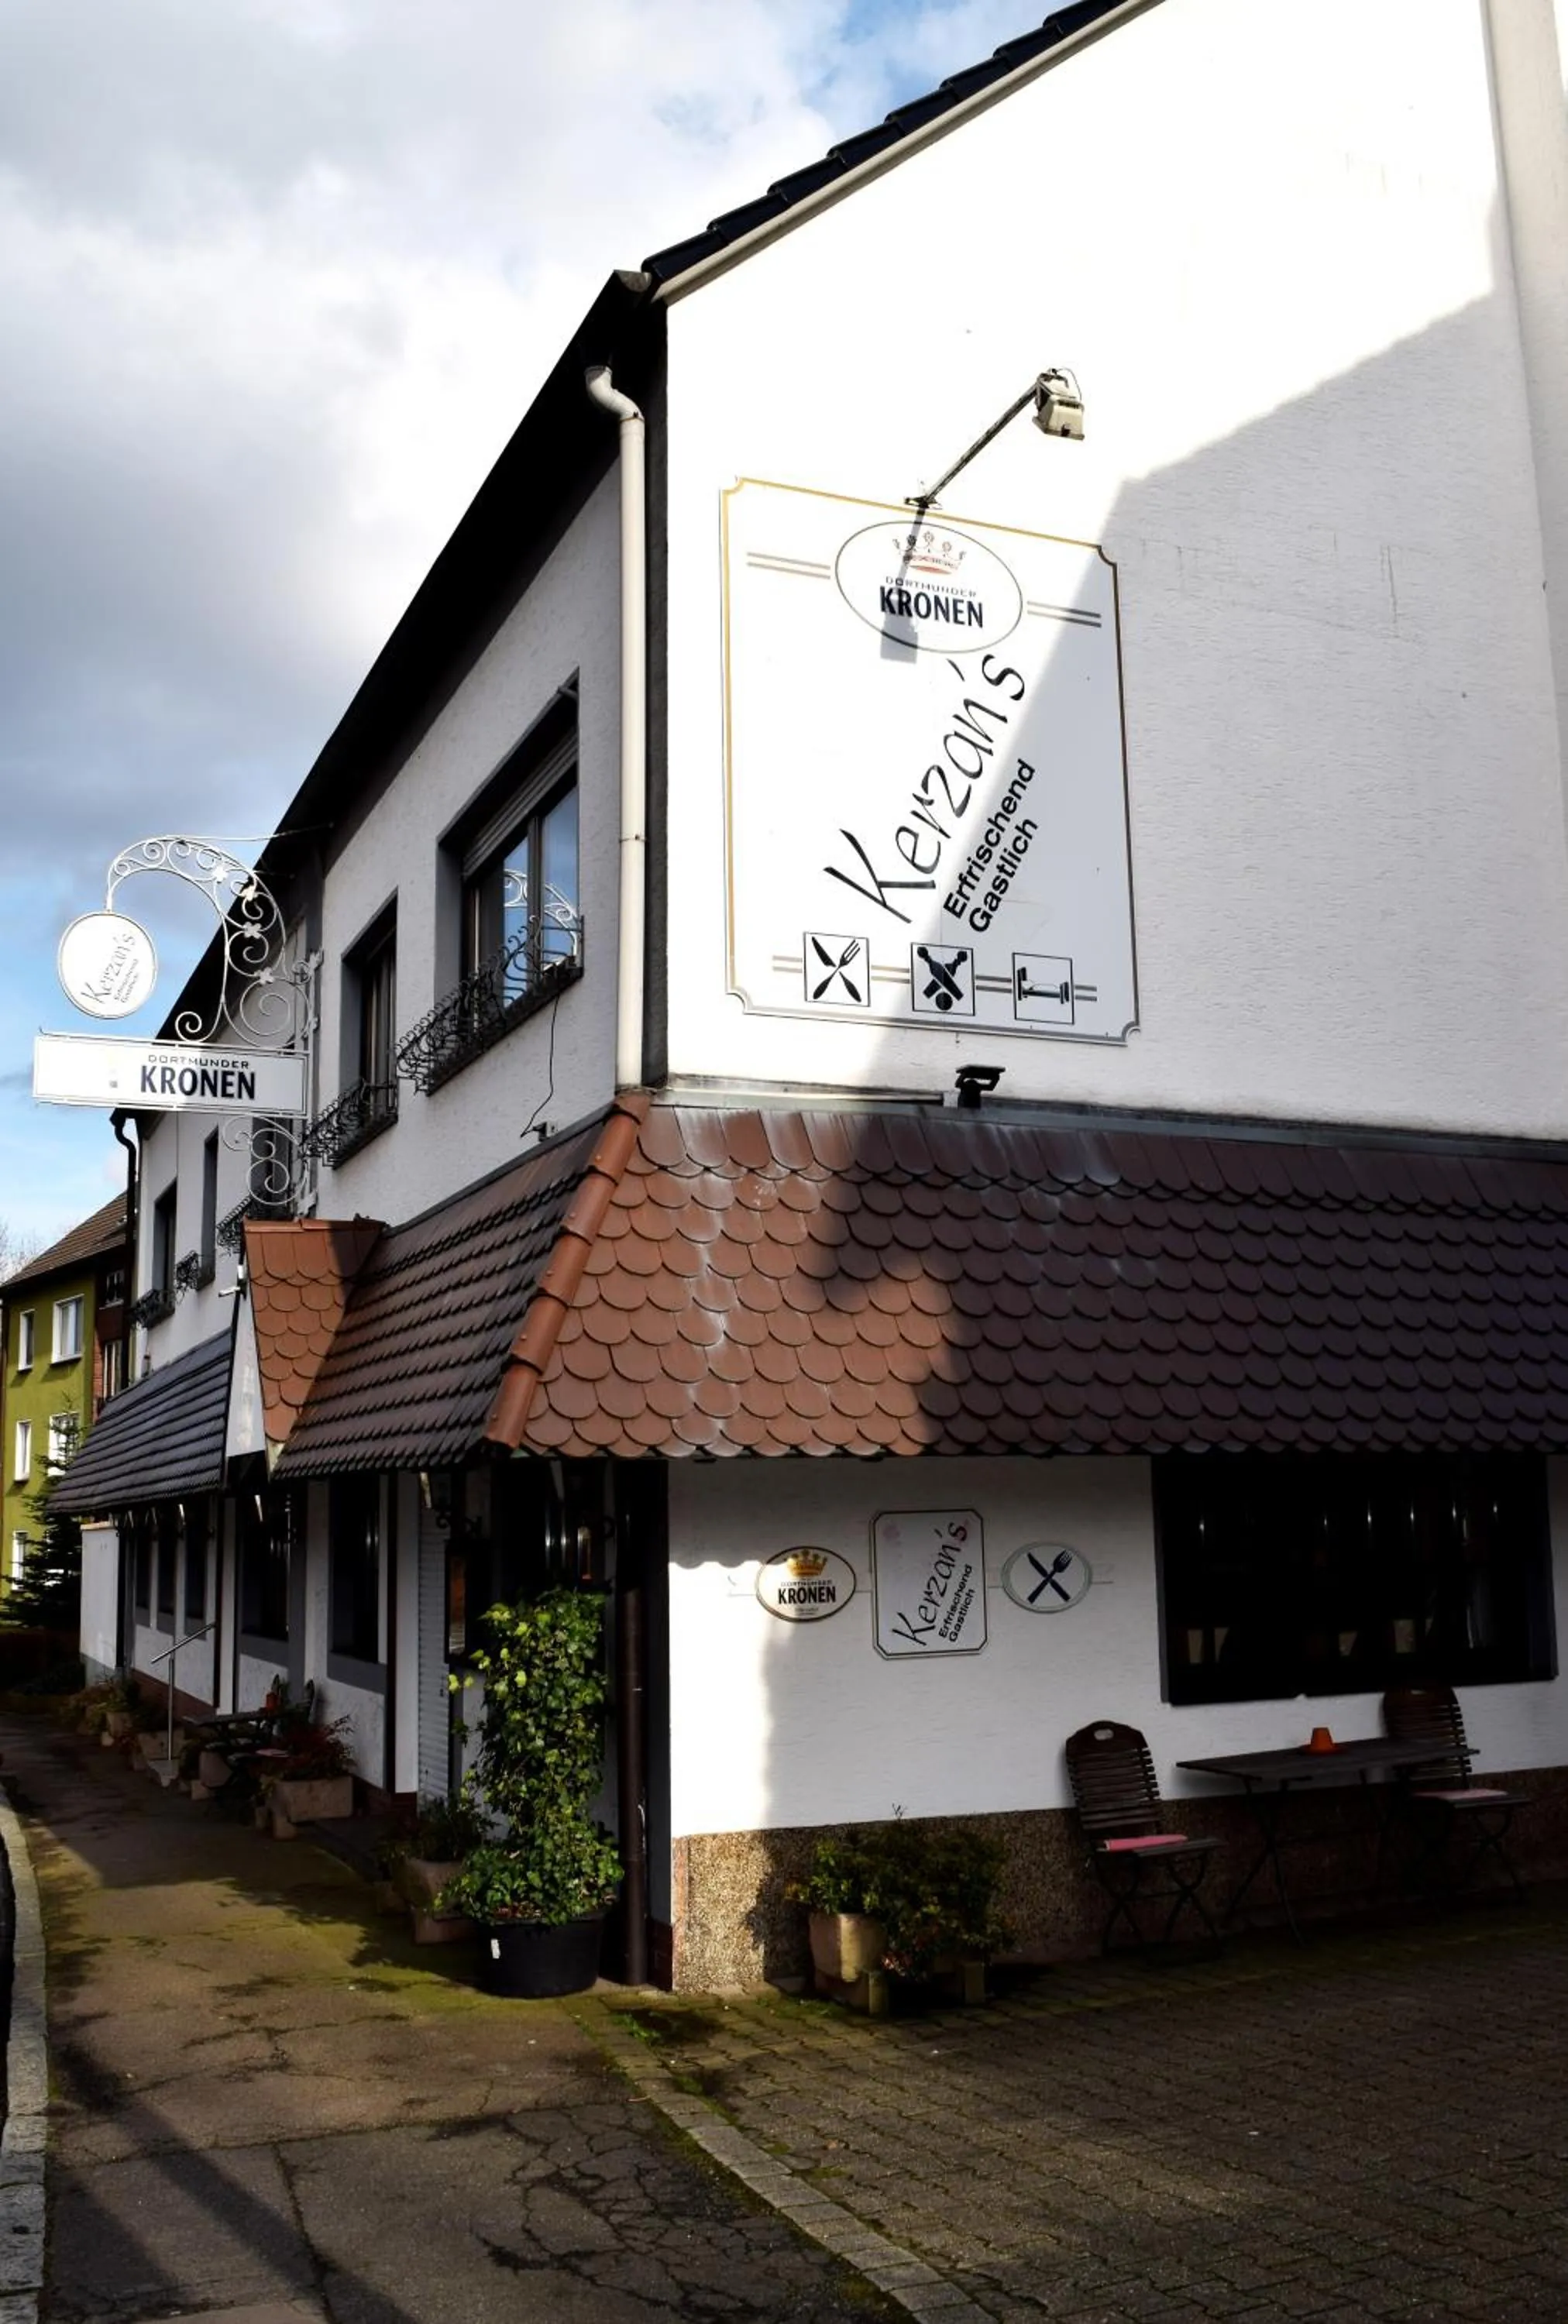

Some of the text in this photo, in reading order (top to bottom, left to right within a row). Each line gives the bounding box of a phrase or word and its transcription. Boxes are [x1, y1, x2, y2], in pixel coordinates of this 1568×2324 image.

[879, 585, 983, 628] KRONEN
[885, 576, 976, 597] DORTMUNDER
[943, 758, 1036, 920] Erfrischend
[968, 817, 1038, 933] Gastlich
[140, 1065, 256, 1100] KRONEN
[148, 1054, 250, 1069] DORTMUNDER
[778, 1586, 836, 1604] KRONEN
[938, 1563, 972, 1639] Erfrischend
[949, 1588, 976, 1643] Gastlich
